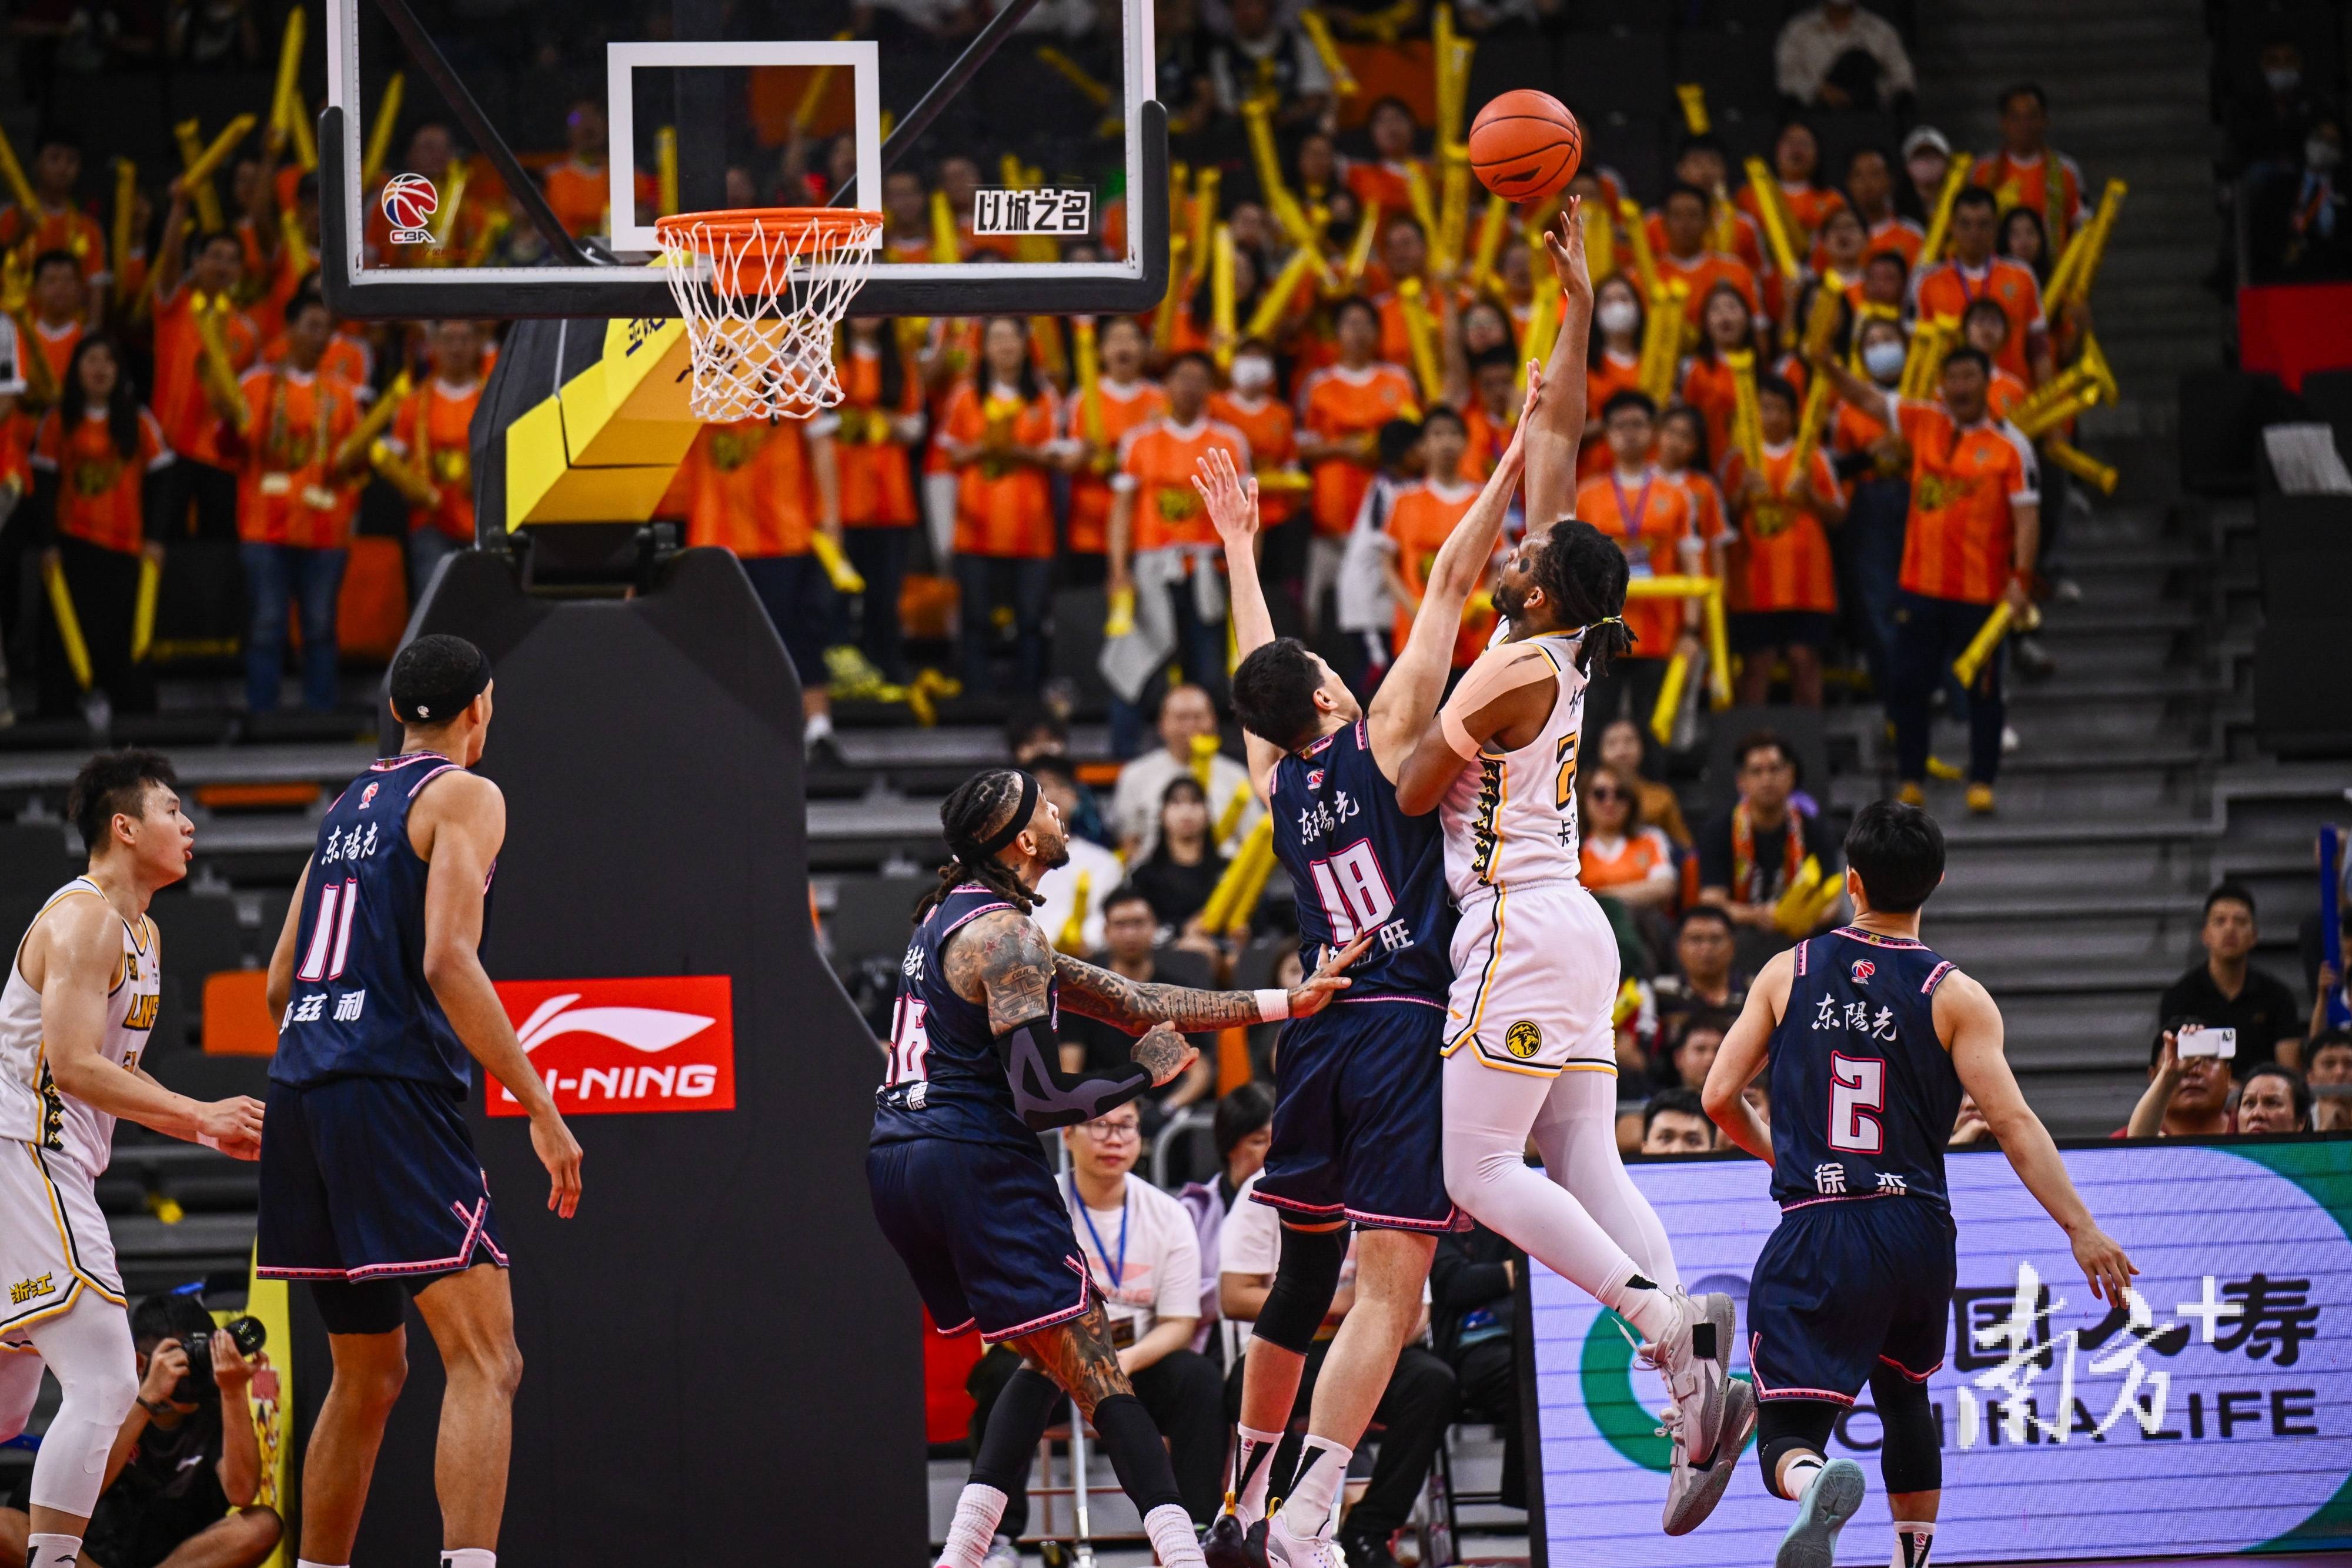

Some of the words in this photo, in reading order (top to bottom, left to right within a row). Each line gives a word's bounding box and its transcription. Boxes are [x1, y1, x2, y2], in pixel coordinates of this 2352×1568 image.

[391, 230, 435, 243] CBA
[976, 191, 1088, 233] 以城之名
[1310, 838, 1396, 946] 18
[297, 877, 357, 981] 11
[1828, 1049, 1886, 1155] 2
[9, 1271, 56, 1305] 浙江
